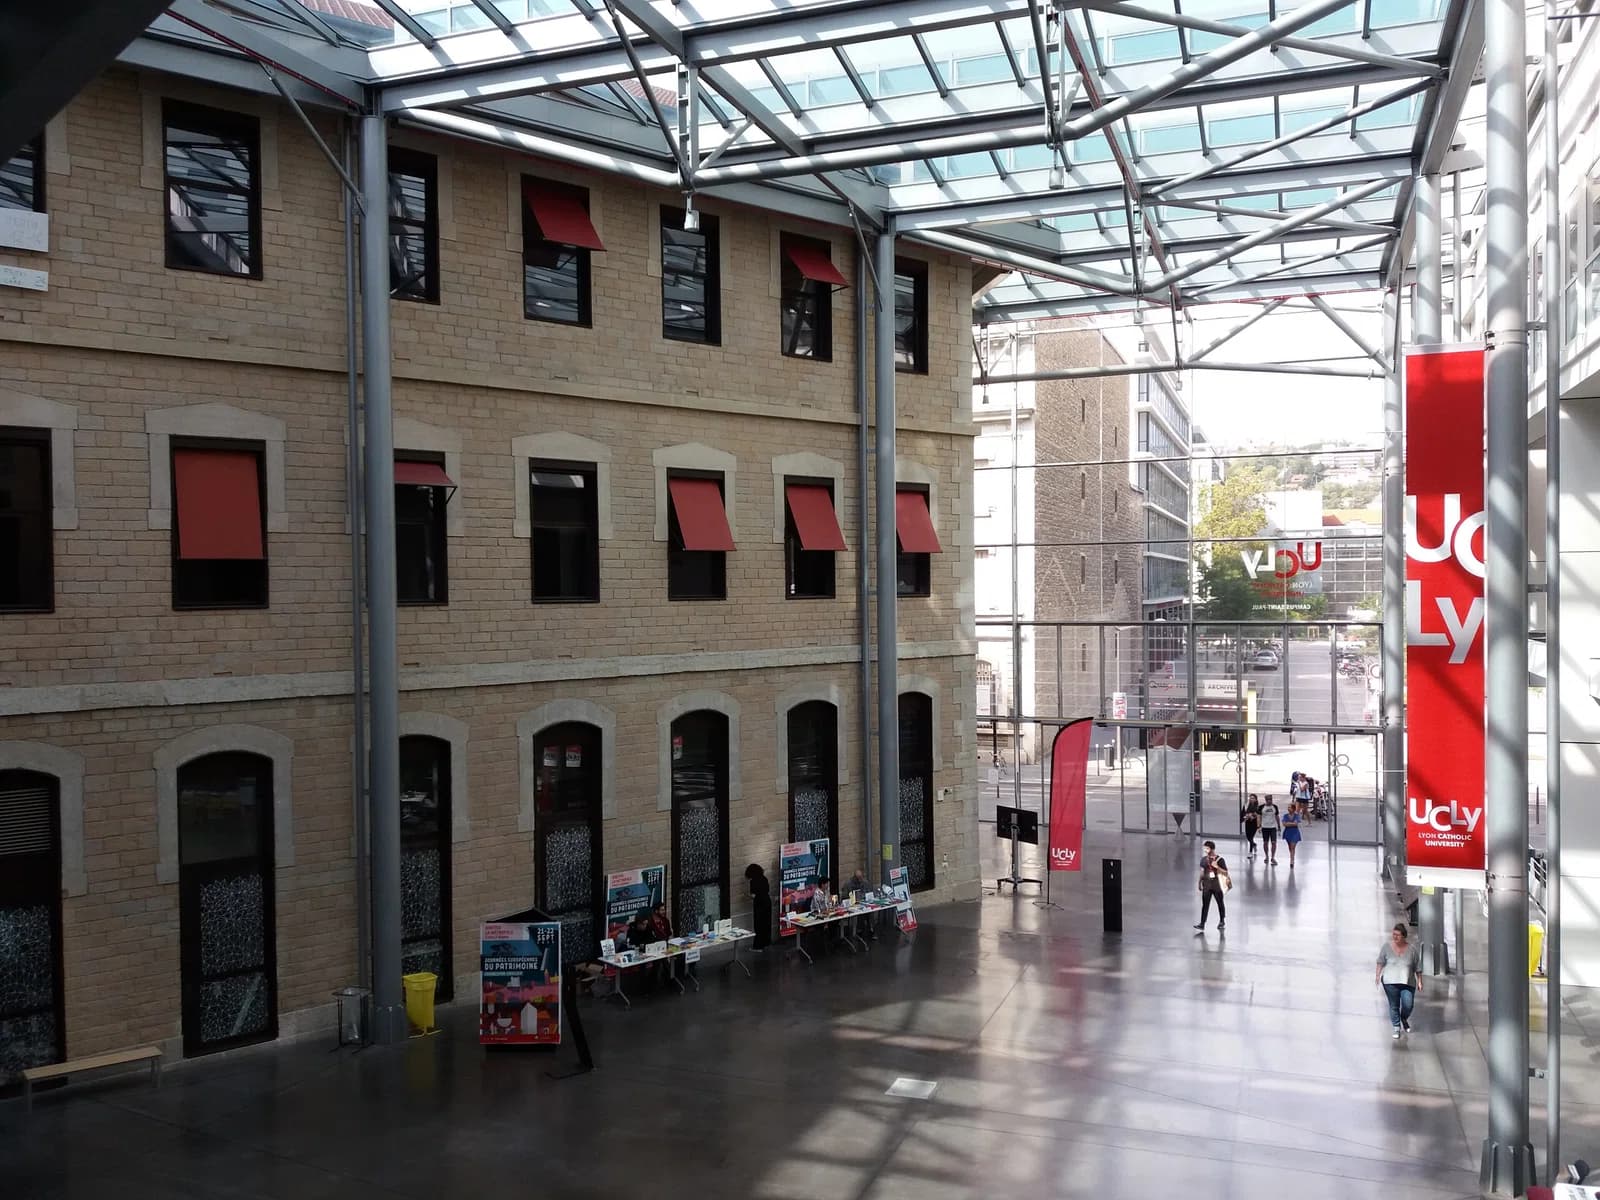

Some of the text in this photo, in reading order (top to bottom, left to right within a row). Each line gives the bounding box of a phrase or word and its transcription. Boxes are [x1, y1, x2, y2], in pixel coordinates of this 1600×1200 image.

[1409, 798, 1482, 832] UCLy
[1437, 833, 1472, 841] CATHOLIC
[1425, 840, 1464, 848] UNIVERSITY
[1052, 848, 1076, 860] UCLy
[611, 901, 649, 914] DU PATRIMOINE
[495, 962, 538, 970] PATRIMOINE
